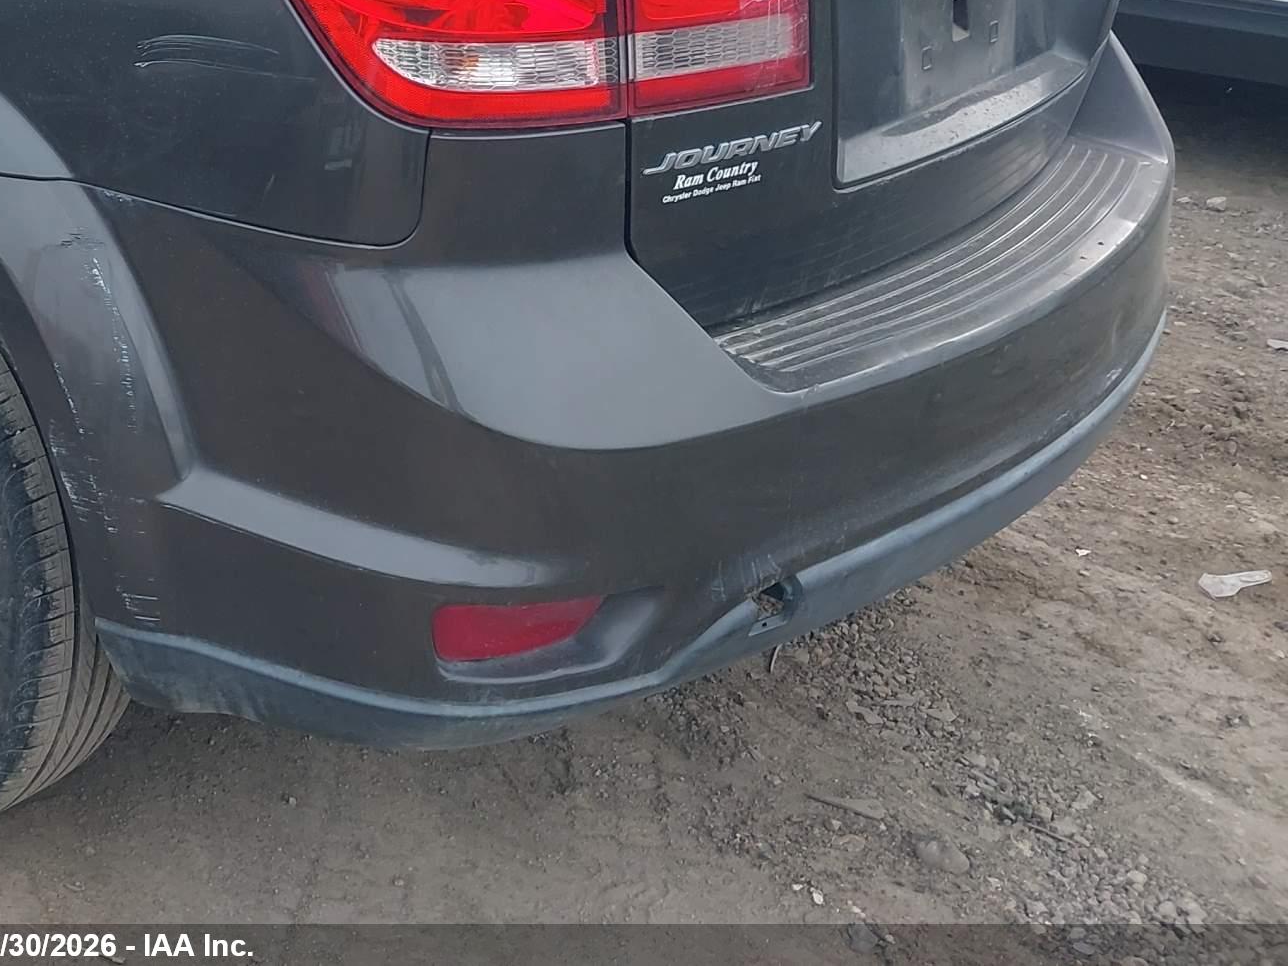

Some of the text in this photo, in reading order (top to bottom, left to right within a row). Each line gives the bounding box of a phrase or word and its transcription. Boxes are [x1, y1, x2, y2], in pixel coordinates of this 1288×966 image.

[642, 120, 823, 176] JOURNEY
[662, 190, 692, 204] Chrysler
[692, 185, 714, 198] Dodge
[715, 181, 732, 193] Jeep
[732, 178, 747, 189] Ram
[672, 160, 759, 191] Ram Country
